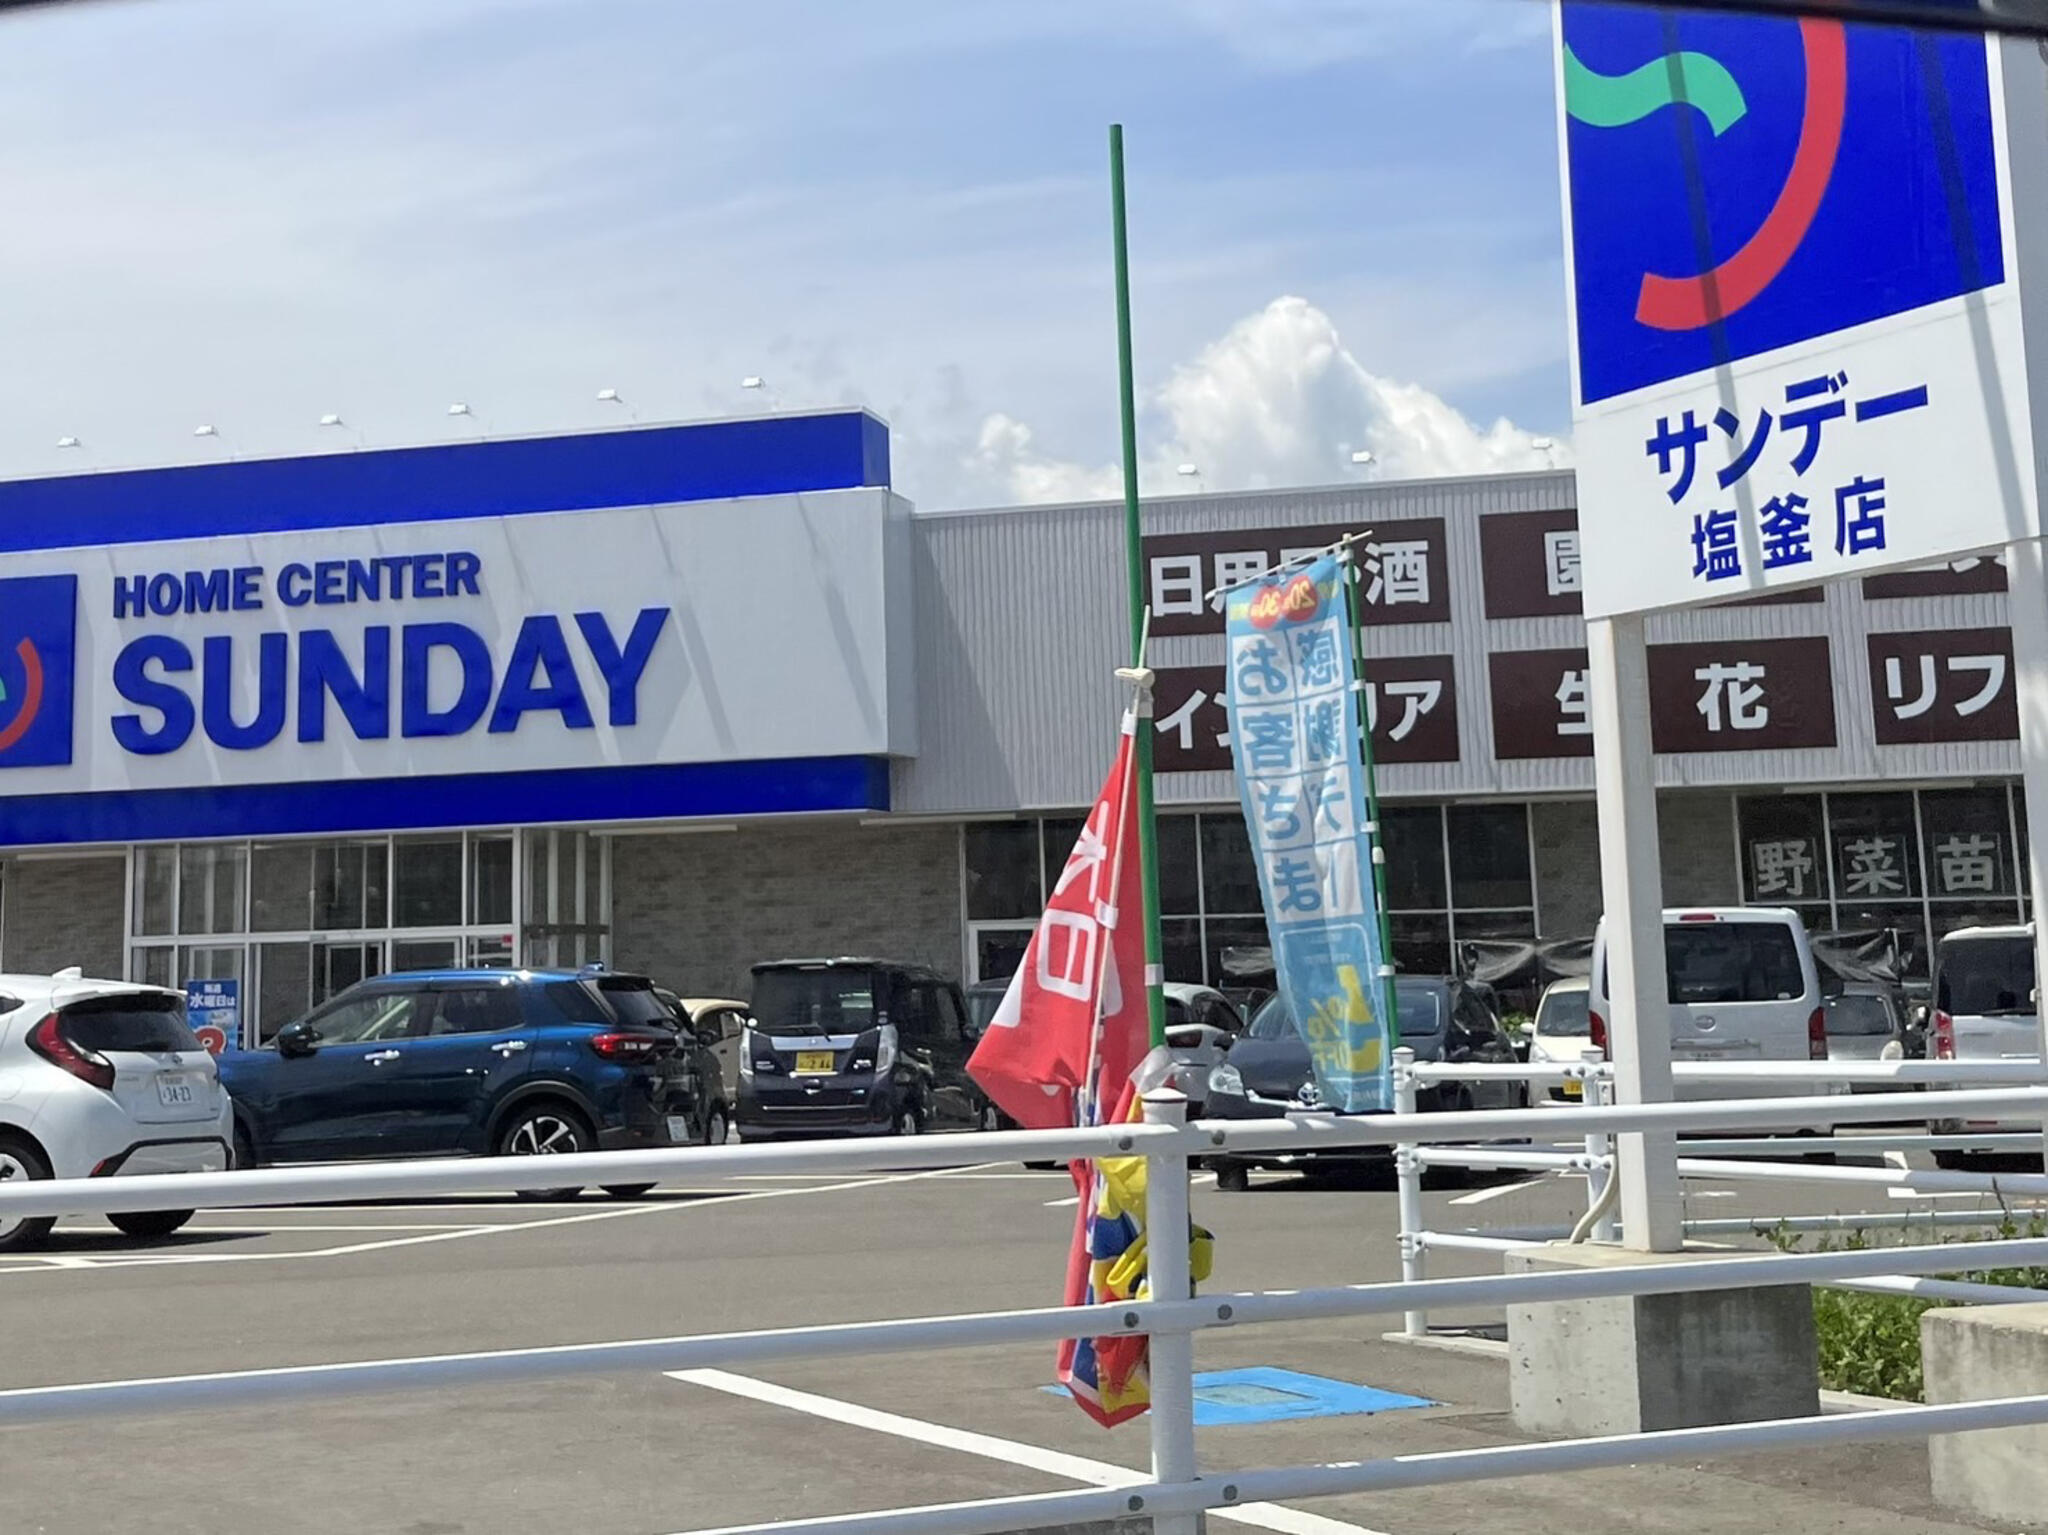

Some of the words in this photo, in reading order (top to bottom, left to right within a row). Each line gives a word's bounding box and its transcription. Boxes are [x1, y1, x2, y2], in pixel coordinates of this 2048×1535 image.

[1646, 370, 1928, 505] サンデー
[1691, 476, 1886, 582] 塩釜店
[113, 566, 263, 619] HOME
[277, 551, 481, 607] CENTER
[111, 607, 671, 755] SUNDAY
[1755, 834, 1995, 896] 野菜苗
